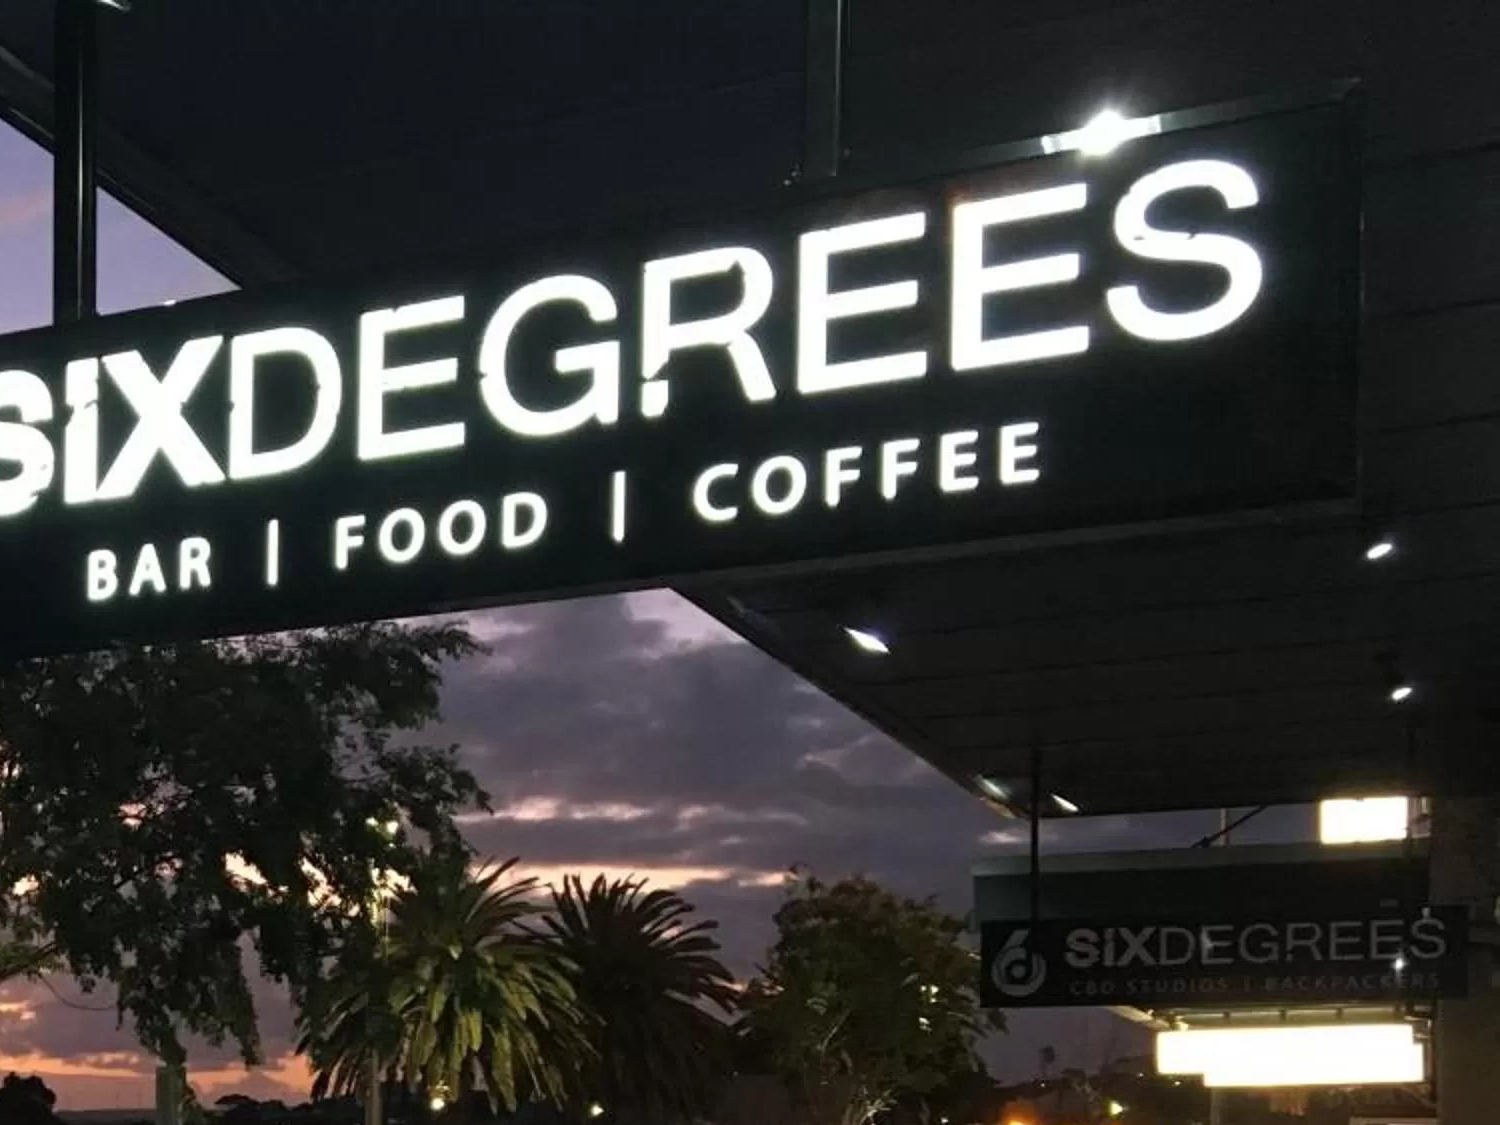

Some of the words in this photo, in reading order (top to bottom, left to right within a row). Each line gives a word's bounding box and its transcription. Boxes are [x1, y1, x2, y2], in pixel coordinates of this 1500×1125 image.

[86, 536, 212, 603] BAR
[333, 490, 549, 571] FOOD
[692, 420, 1041, 523] COFFEE
[1063, 917, 1447, 969] SIXDEGREES
[1125, 975, 1229, 995] STUDIOS
